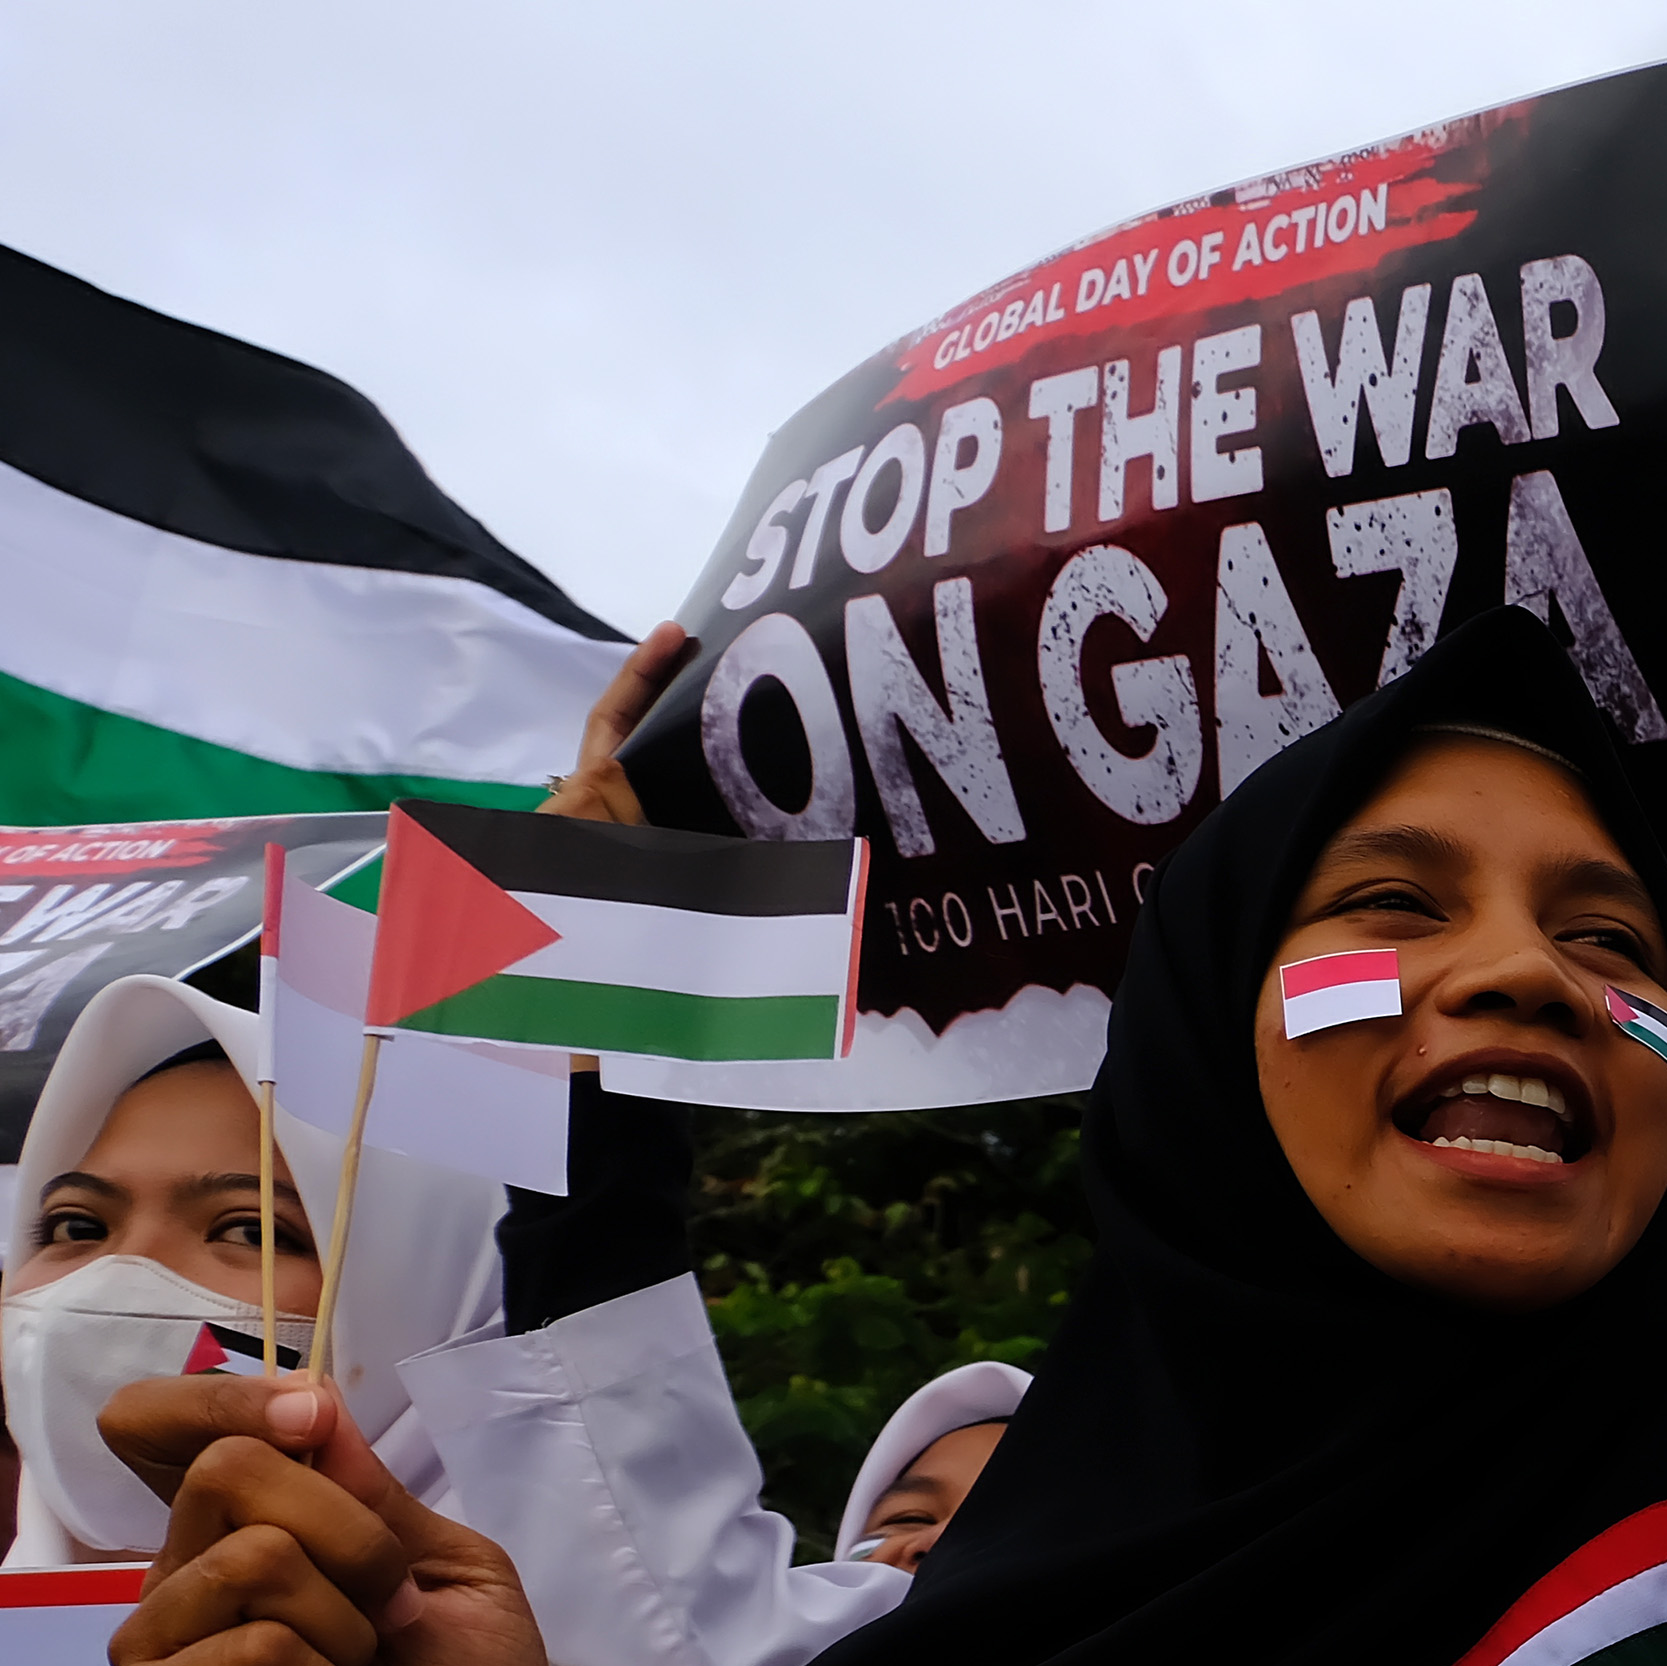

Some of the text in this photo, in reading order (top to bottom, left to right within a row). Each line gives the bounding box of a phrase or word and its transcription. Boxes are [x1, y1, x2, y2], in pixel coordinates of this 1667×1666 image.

[934, 184, 1389, 370] GLOBAL DAY OF ACTION
[720, 254, 1619, 611] STOP THE WAR
[701, 577, 1025, 859] ON
[0, 876, 249, 946] WAR
[47, 838, 177, 862] ACTION
[885, 892, 973, 956] 100
[987, 870, 1118, 940] HARI
